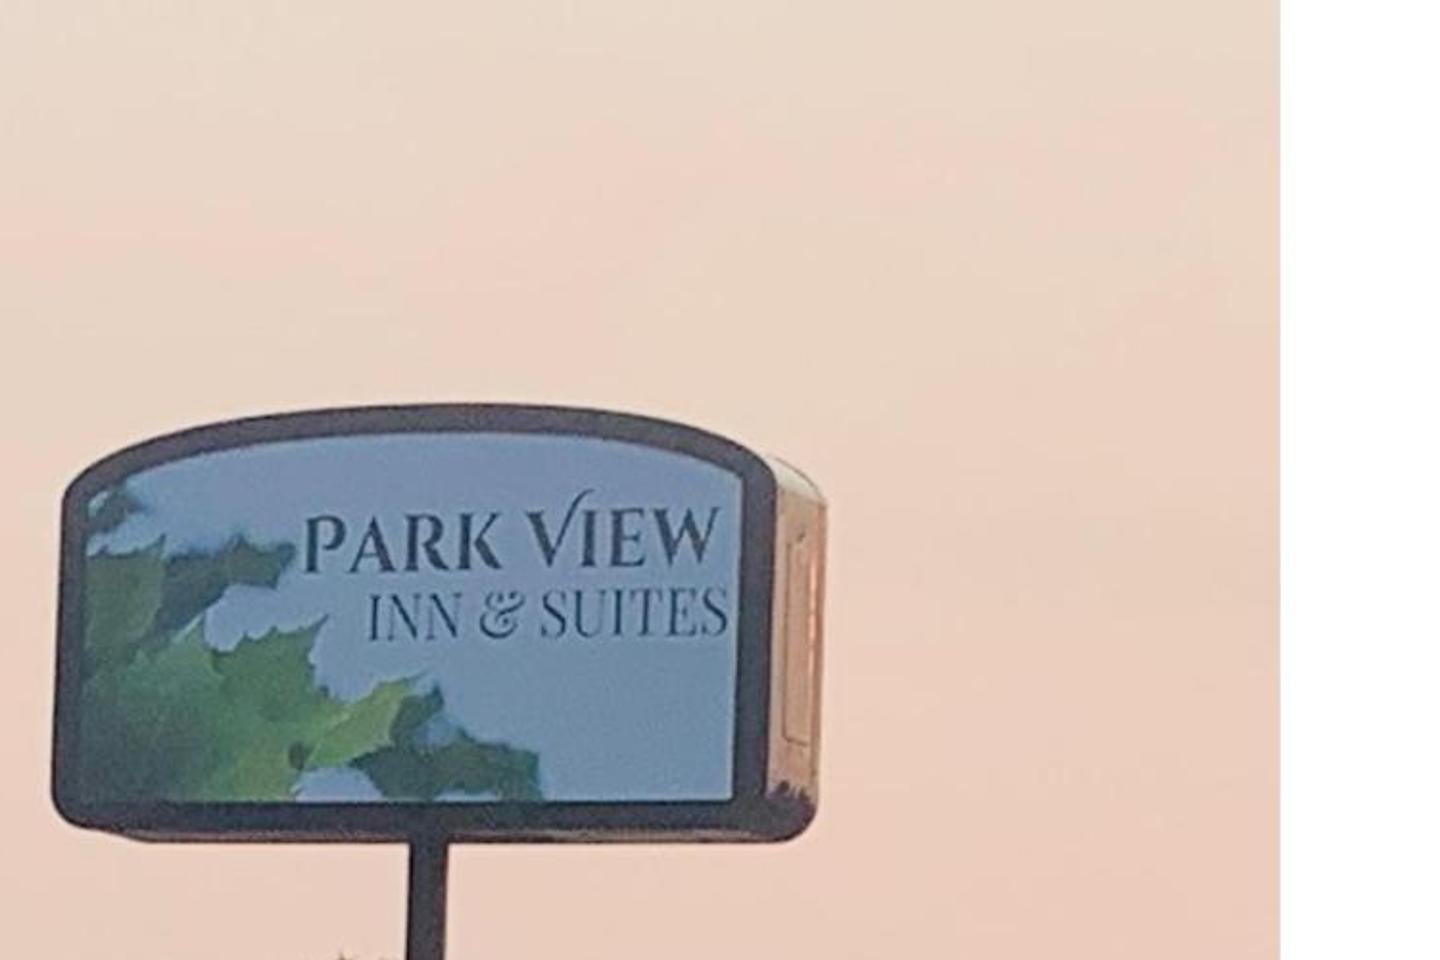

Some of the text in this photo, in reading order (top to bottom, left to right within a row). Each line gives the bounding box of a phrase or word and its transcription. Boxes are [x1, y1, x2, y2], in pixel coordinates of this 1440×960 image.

[304, 488, 721, 574] PARK VIEW
[368, 586, 728, 642] INN & SUITES
